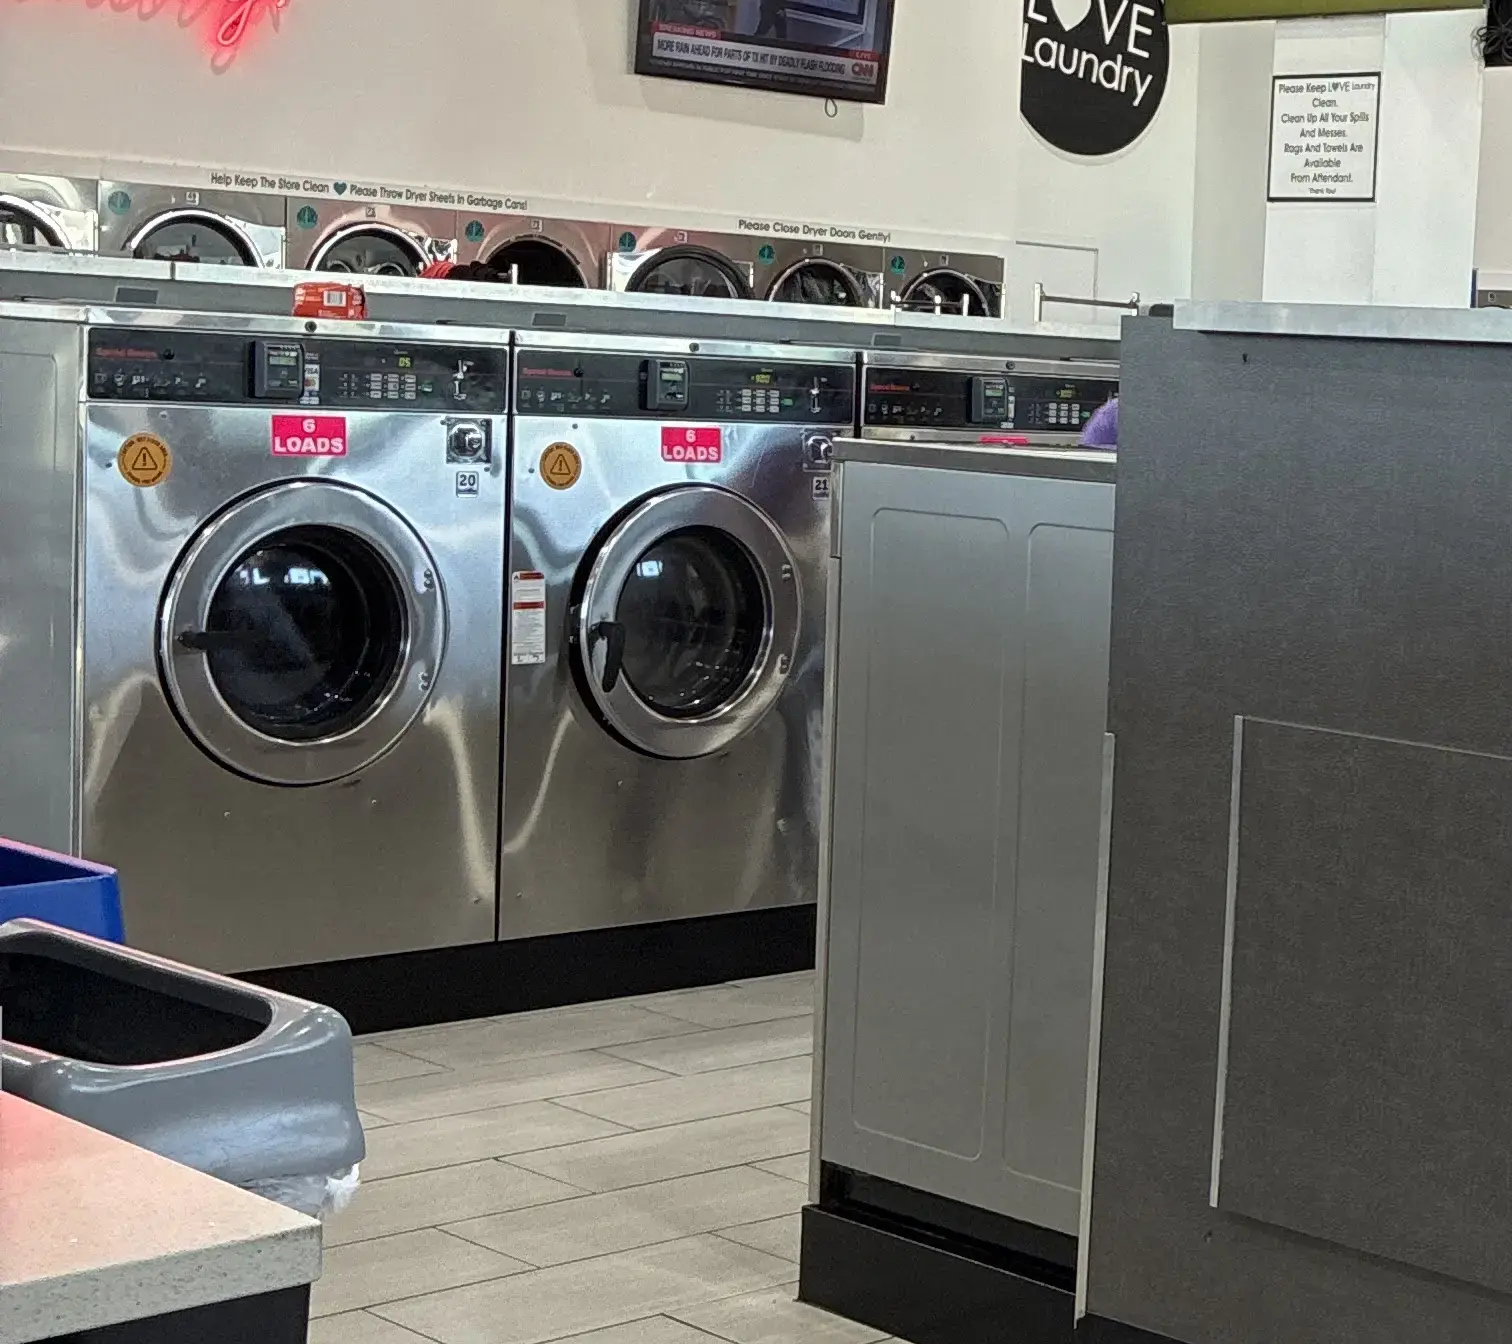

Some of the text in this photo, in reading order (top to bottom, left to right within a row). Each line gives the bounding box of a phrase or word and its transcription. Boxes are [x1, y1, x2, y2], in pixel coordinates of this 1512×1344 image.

[852, 62, 874, 77] CNN
[1021, 22, 1153, 106] Laundry
[211, 173, 232, 187] Help
[235, 174, 258, 189] Keep
[260, 176, 276, 189] The
[278, 178, 300, 190] Store
[302, 180, 329, 193] Clean
[350, 184, 377, 197] Please
[380, 187, 403, 199] Throw
[406, 189, 427, 202] Dryer
[429, 191, 455, 204] Sheets
[457, 193, 464, 204] In
[467, 195, 503, 210] Garbage
[738, 219, 770, 233] Please
[773, 222, 799, 234] Close
[802, 224, 827, 237] Dryer
[830, 227, 855, 239] Doors
[302, 419, 316, 432] 6
[685, 430, 696, 443] 6
[274, 437, 344, 453] LOADS
[662, 445, 719, 461] LOADS
[459, 474, 476, 486] 20
[815, 479, 829, 491] 21
